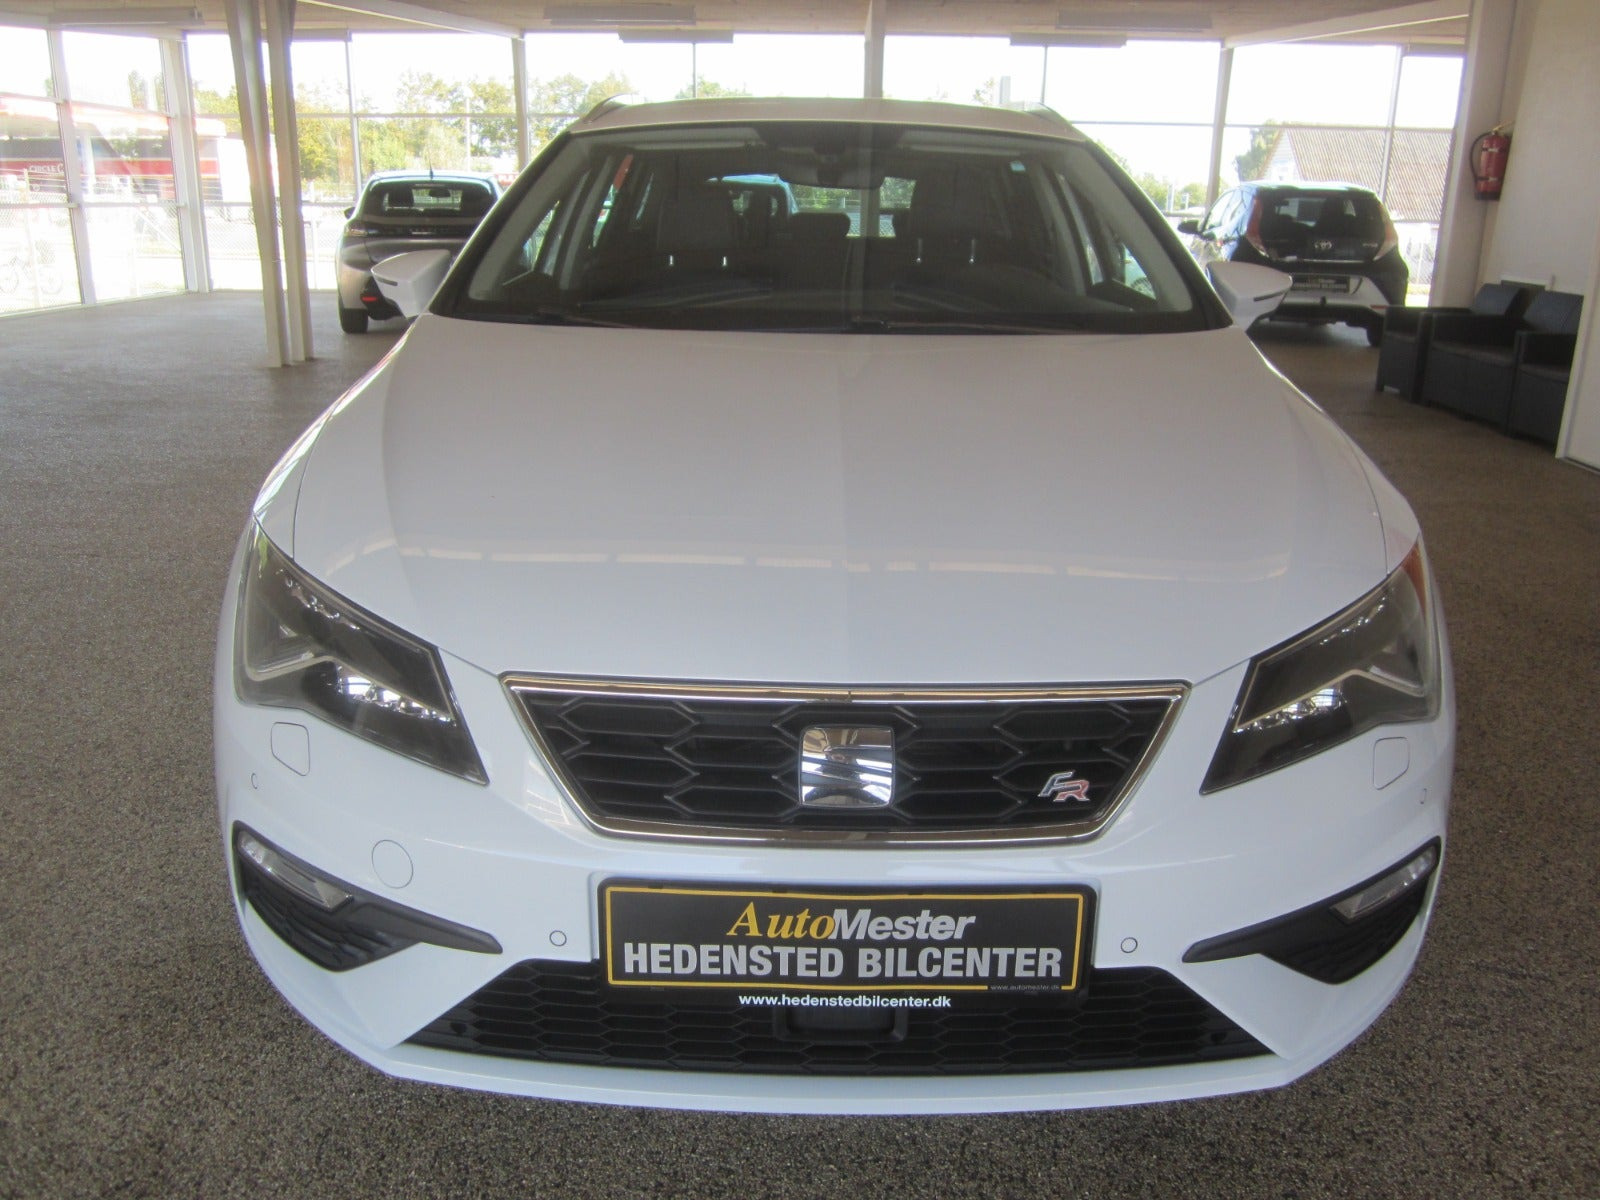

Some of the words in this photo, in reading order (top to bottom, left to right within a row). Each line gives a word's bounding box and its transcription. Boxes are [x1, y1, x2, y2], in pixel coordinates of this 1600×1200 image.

[1037, 771, 1091, 803] FR
[726, 901, 976, 940] AutoMester
[623, 942, 844, 977] HEDENSTED
[857, 946, 1062, 978] BILCENTER
[738, 994, 952, 1008] www.hedenstedbilcenter.dk
